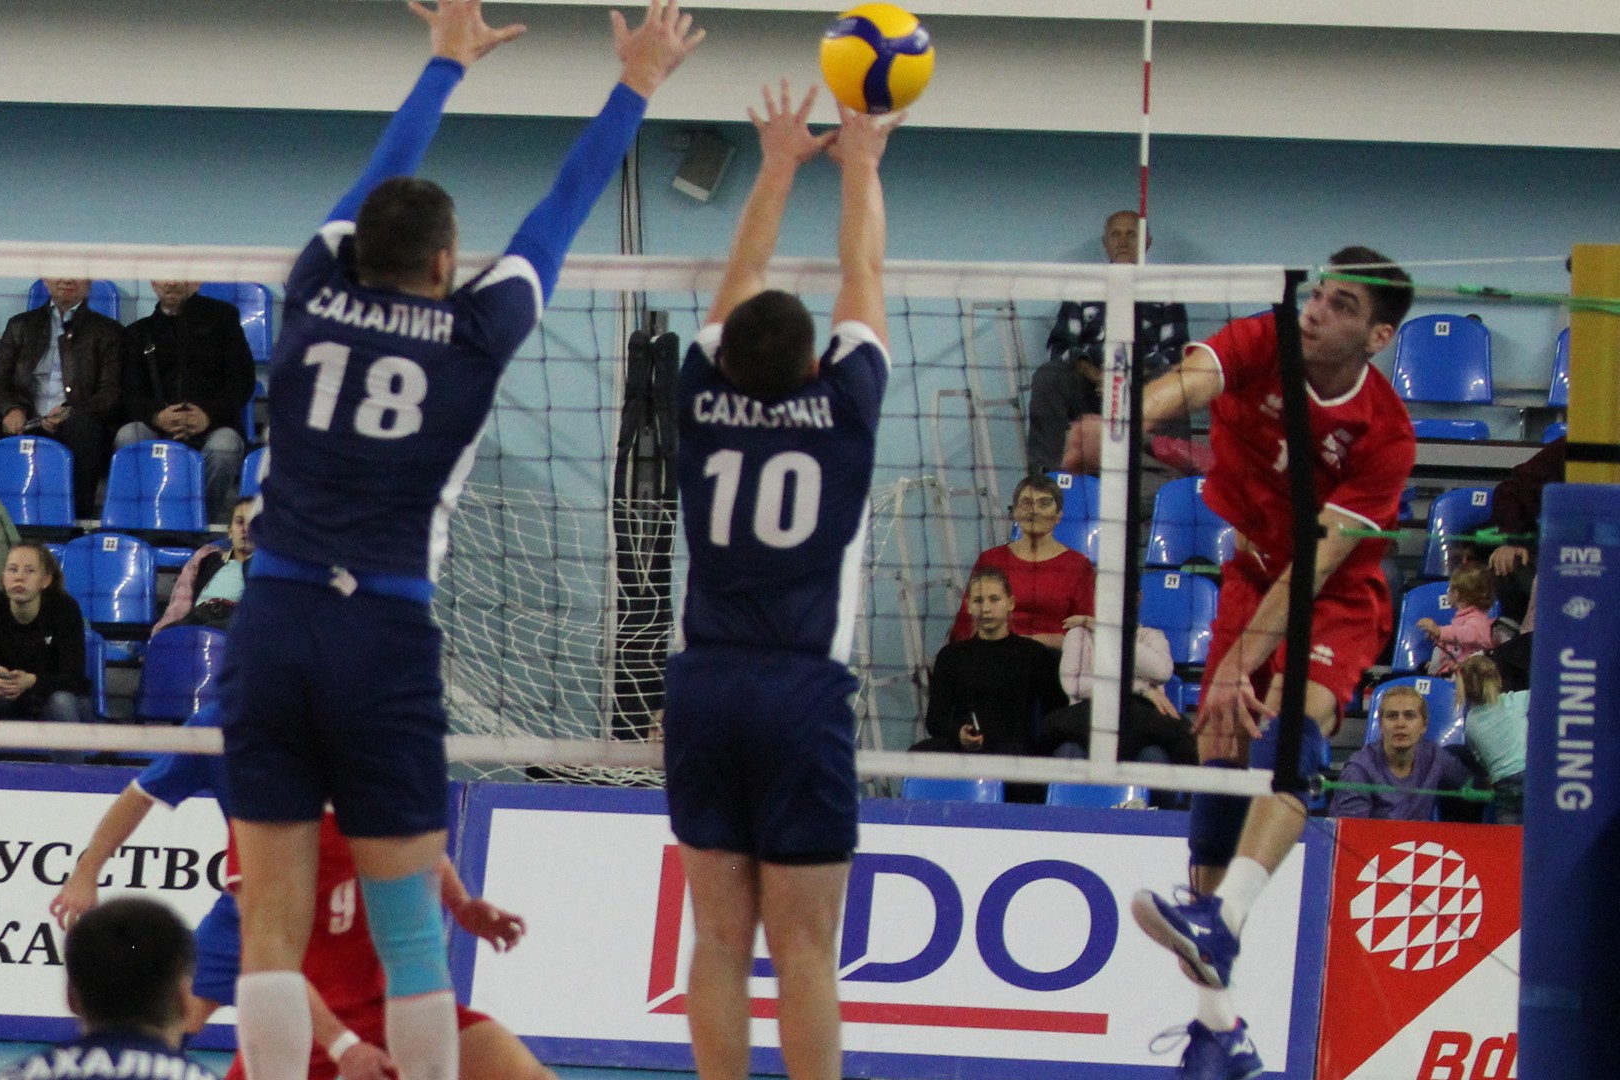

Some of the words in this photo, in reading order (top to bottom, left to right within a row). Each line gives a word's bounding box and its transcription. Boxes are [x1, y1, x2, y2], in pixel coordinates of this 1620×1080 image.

[306, 285, 455, 344] САХАЛИН
[303, 341, 428, 439] 18
[703, 449, 823, 549] 10
[1556, 648, 1597, 811] JINLING
[328, 878, 356, 935] 9
